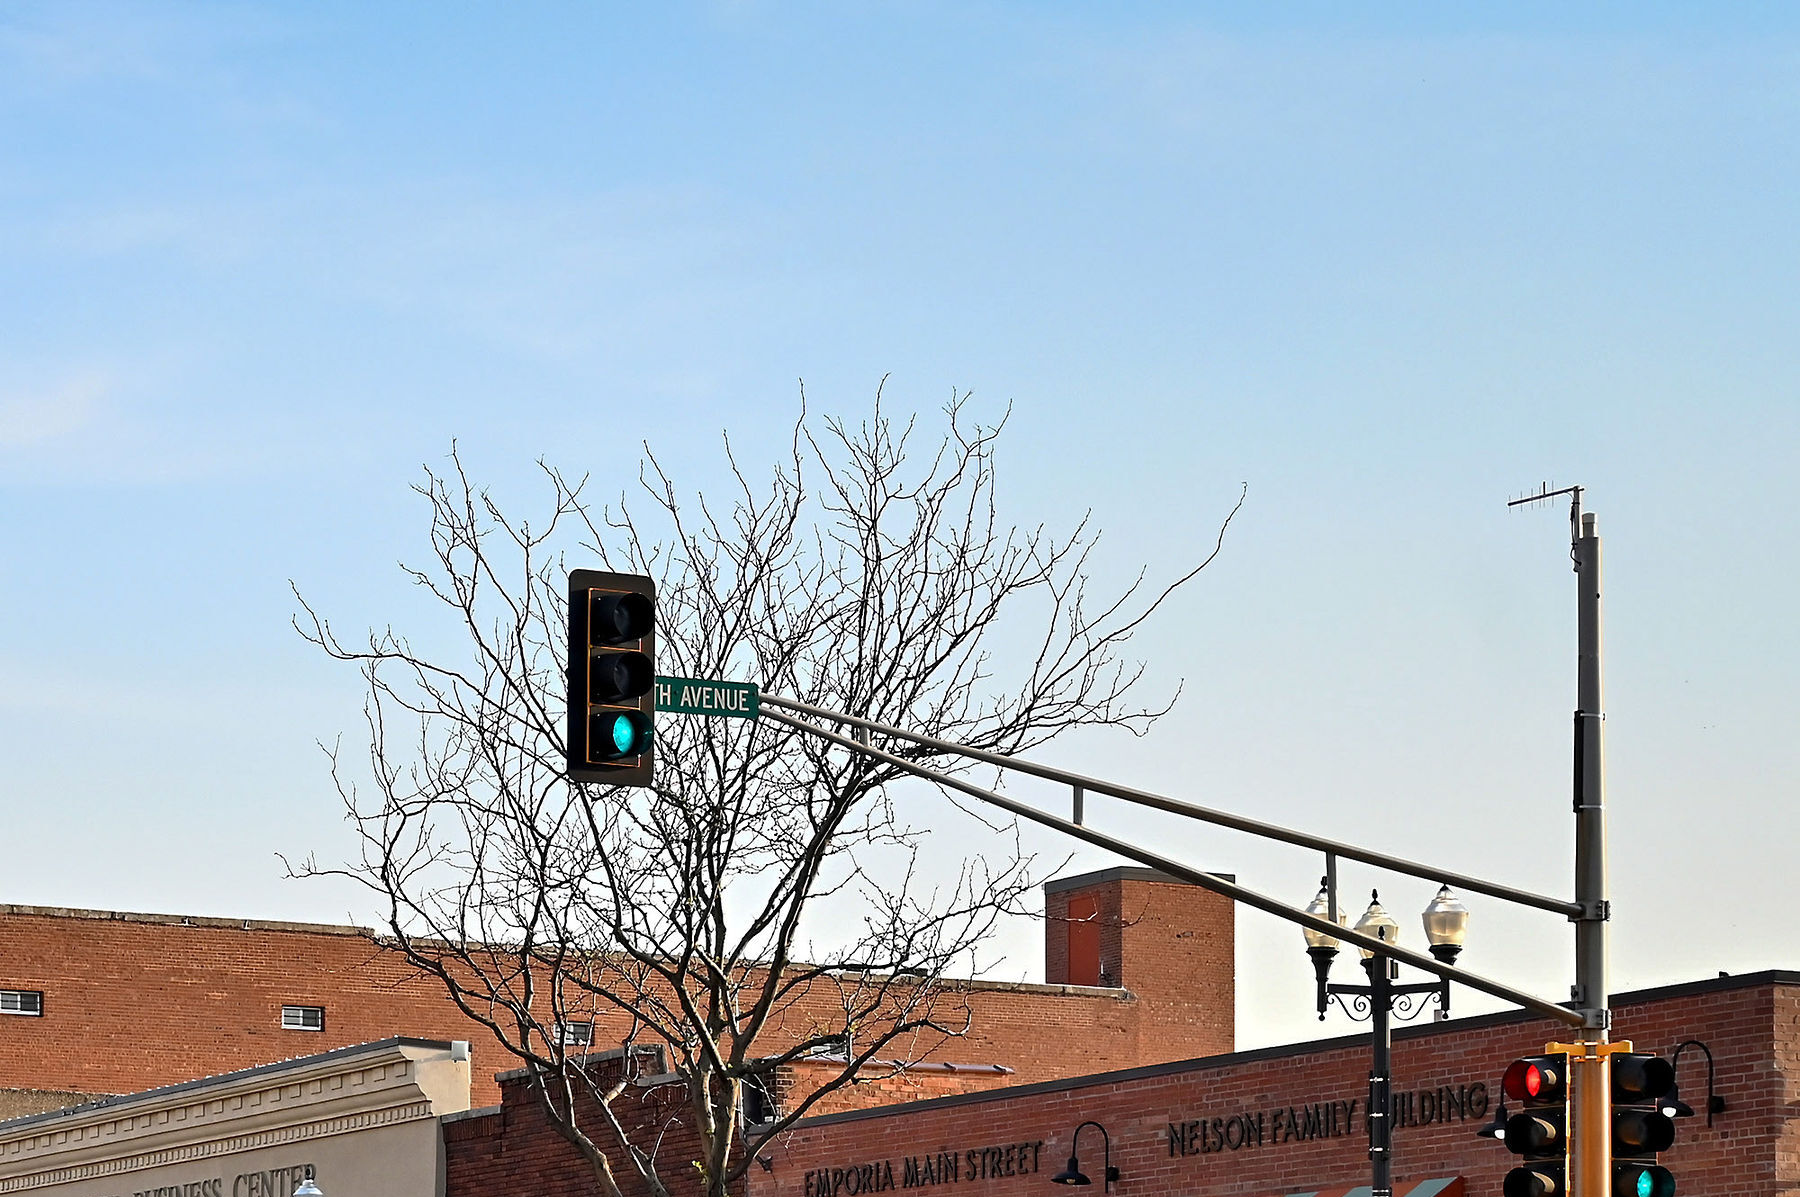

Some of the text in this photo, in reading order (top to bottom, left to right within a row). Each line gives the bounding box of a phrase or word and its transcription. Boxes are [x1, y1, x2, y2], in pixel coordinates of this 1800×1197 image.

[680, 685, 750, 712] AVENUE
[1167, 1082, 1489, 1158] NELSON FAMILY UILDING
[903, 1151, 959, 1189] MAIN
[966, 1139, 1043, 1181] STREET
